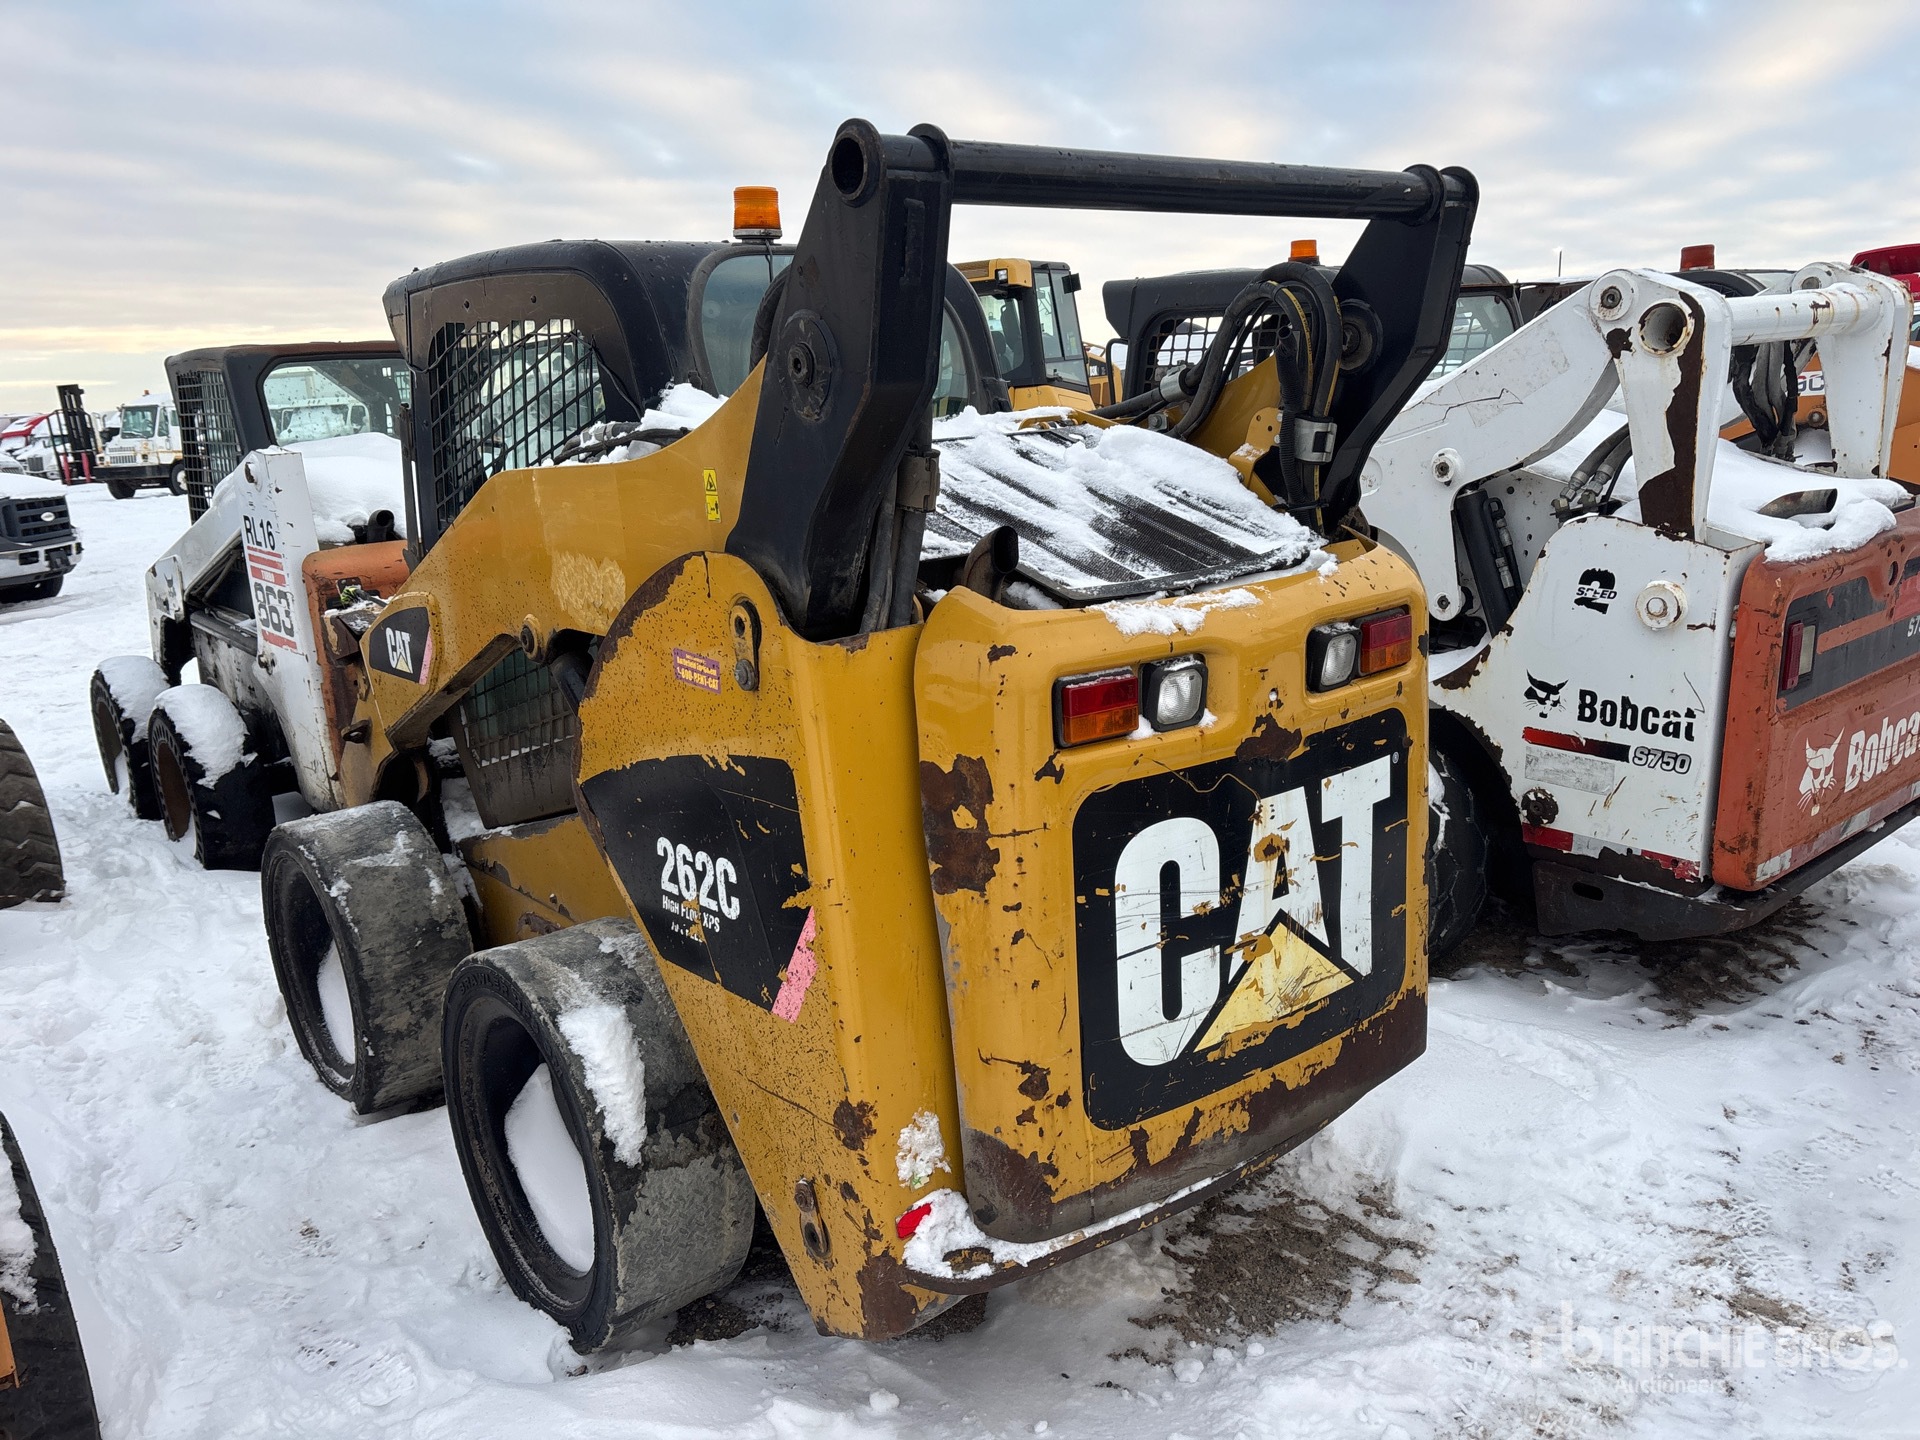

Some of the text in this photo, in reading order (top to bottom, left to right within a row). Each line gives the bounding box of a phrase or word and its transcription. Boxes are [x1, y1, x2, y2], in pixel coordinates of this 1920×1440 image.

[243, 515, 276, 551] RL16
[254, 582, 295, 638] 863
[386, 627, 413, 674] CAT
[1577, 688, 1697, 742] Bobcat
[1632, 746, 1692, 774] S750
[1844, 711, 1920, 793] Bobca
[657, 836, 741, 920] 262C
[662, 895, 680, 915] HIGH
[703, 912, 720, 932] XPS
[1115, 754, 1391, 1066] CAT
